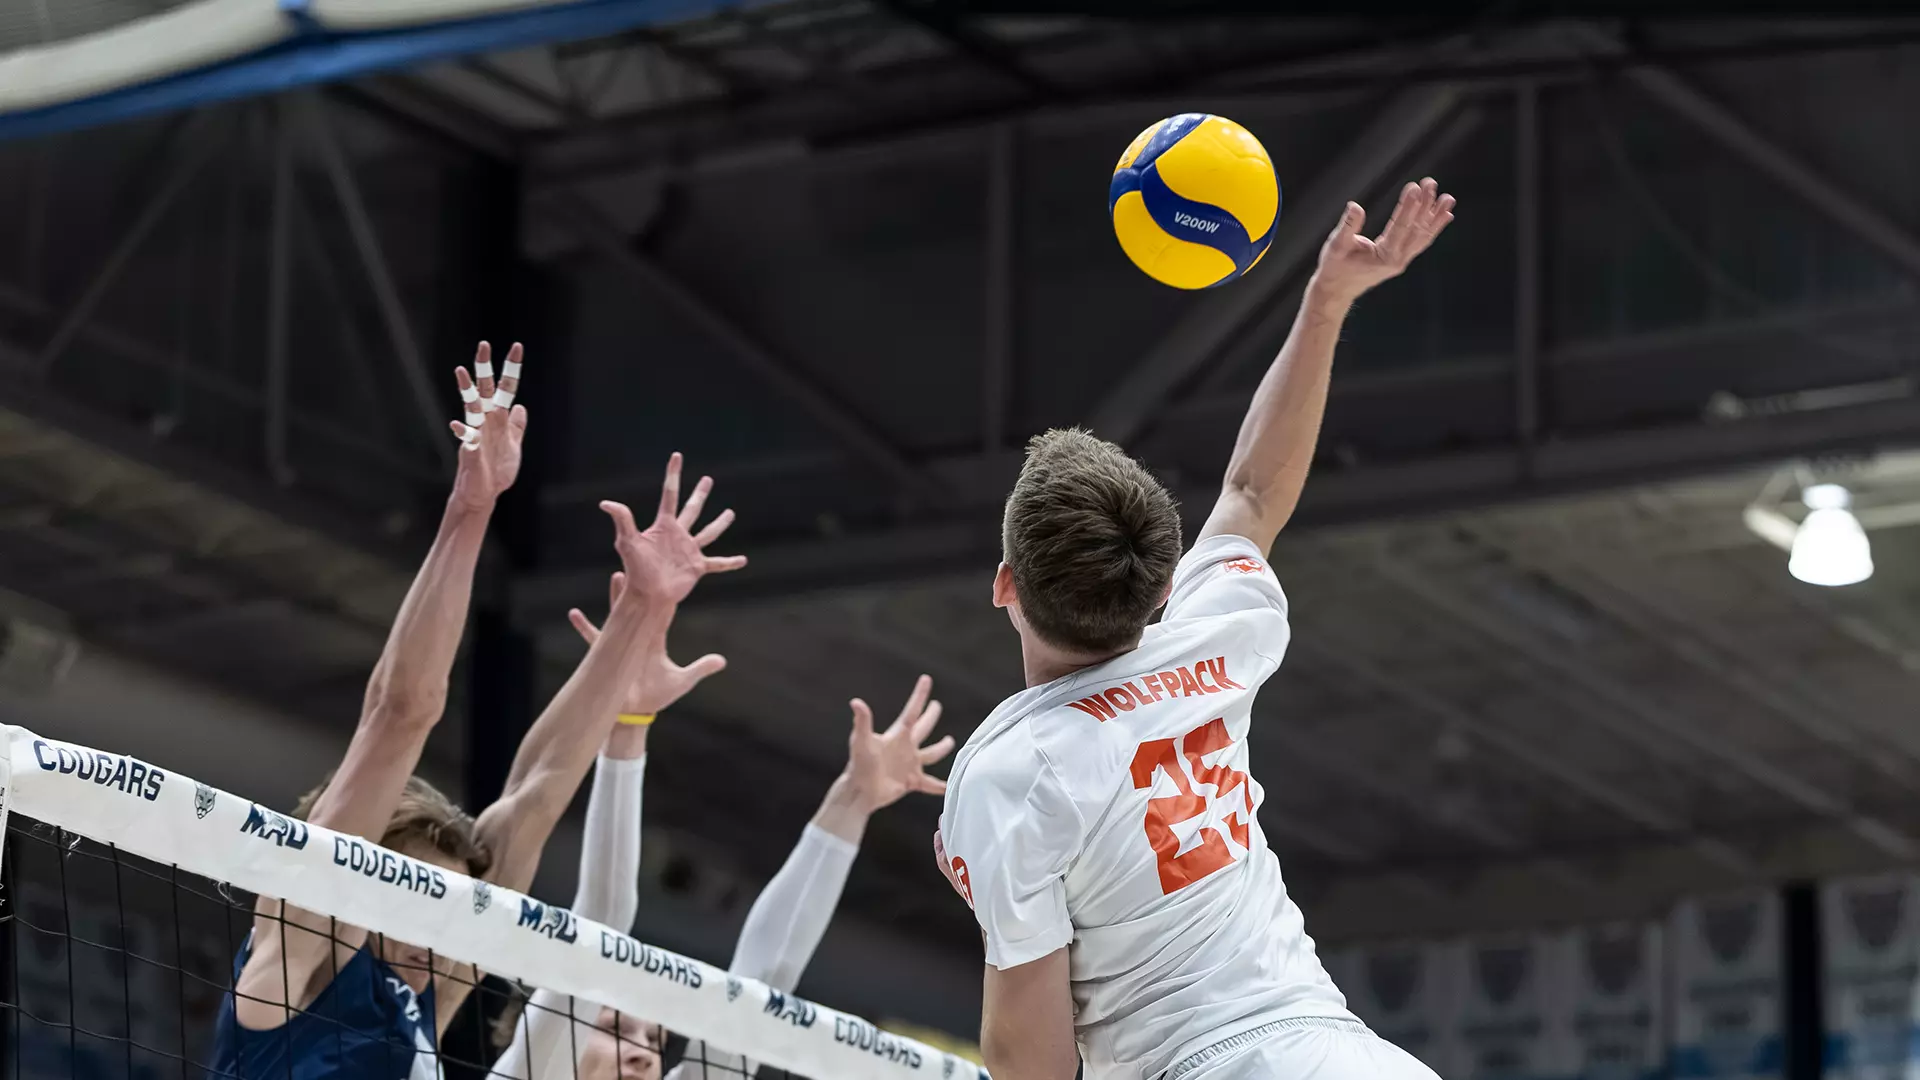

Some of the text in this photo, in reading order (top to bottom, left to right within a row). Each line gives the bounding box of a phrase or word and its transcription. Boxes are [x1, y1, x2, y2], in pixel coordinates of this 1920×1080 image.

[1174, 211, 1220, 234] V200W
[1064, 656, 1247, 723] WOLFPACK
[33, 740, 165, 801] COUGARS
[333, 836, 447, 899] COUGARS
[600, 930, 702, 989] COUGARS
[1129, 717, 1254, 896] 25
